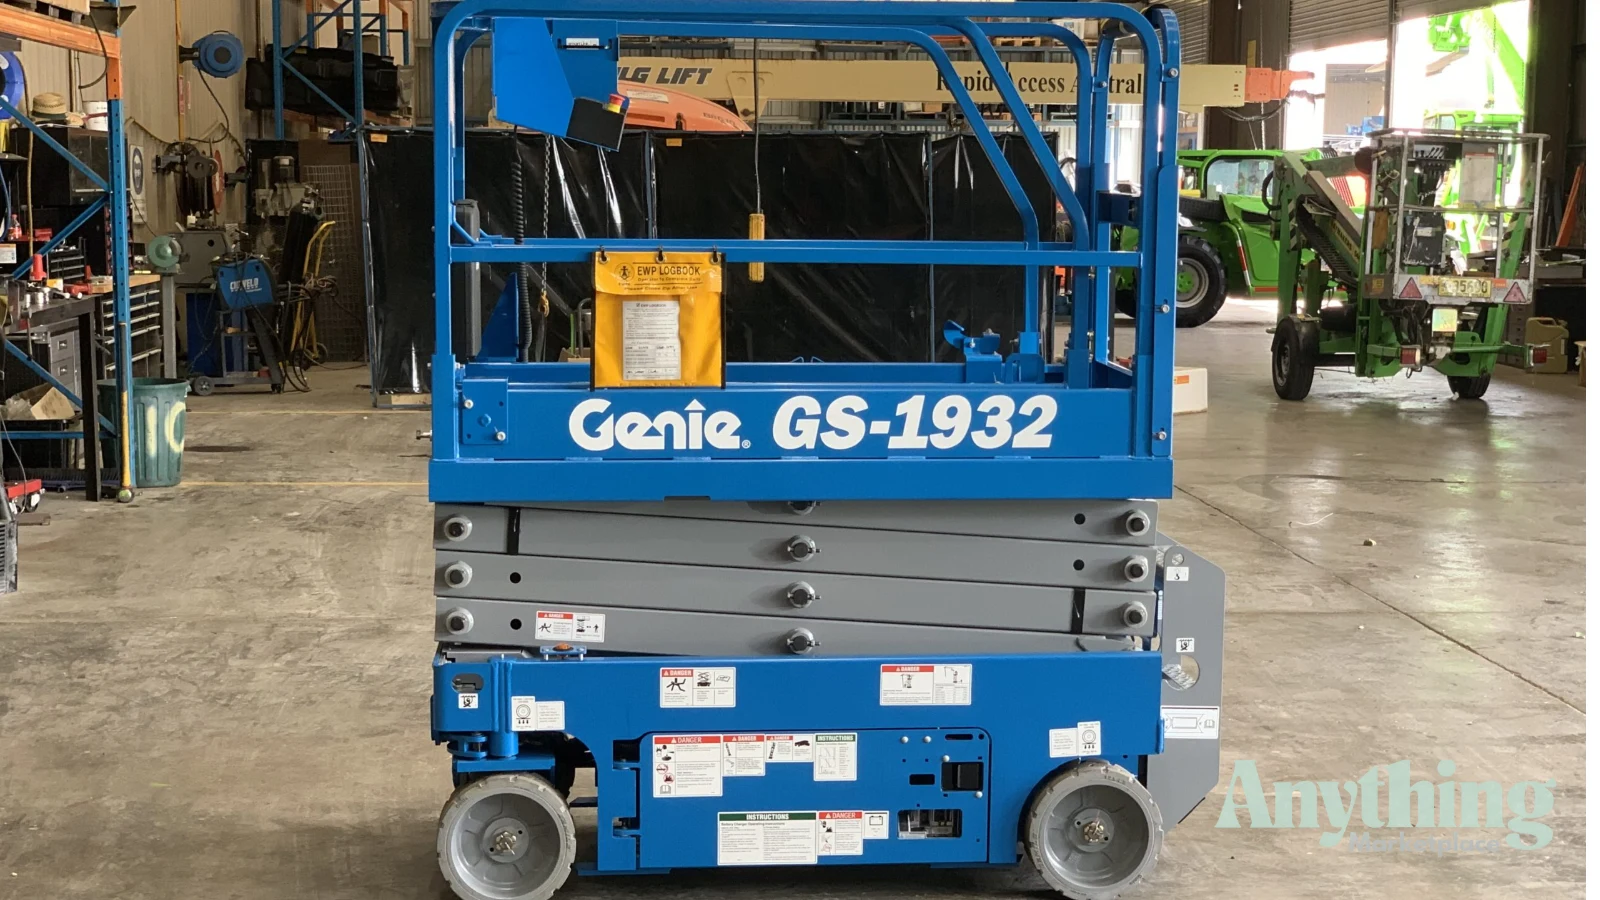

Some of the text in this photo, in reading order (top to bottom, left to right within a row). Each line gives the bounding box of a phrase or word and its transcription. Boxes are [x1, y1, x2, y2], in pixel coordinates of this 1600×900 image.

[617, 66, 713, 85] LG LIFT
[936, 69, 993, 91] Rpid
[1009, 72, 1065, 93] ccess
[637, 266, 700, 276] EWP LOGBOOK
[772, 394, 1058, 450] GS-1932
[817, 734, 854, 742] INSTRUCTIONS
